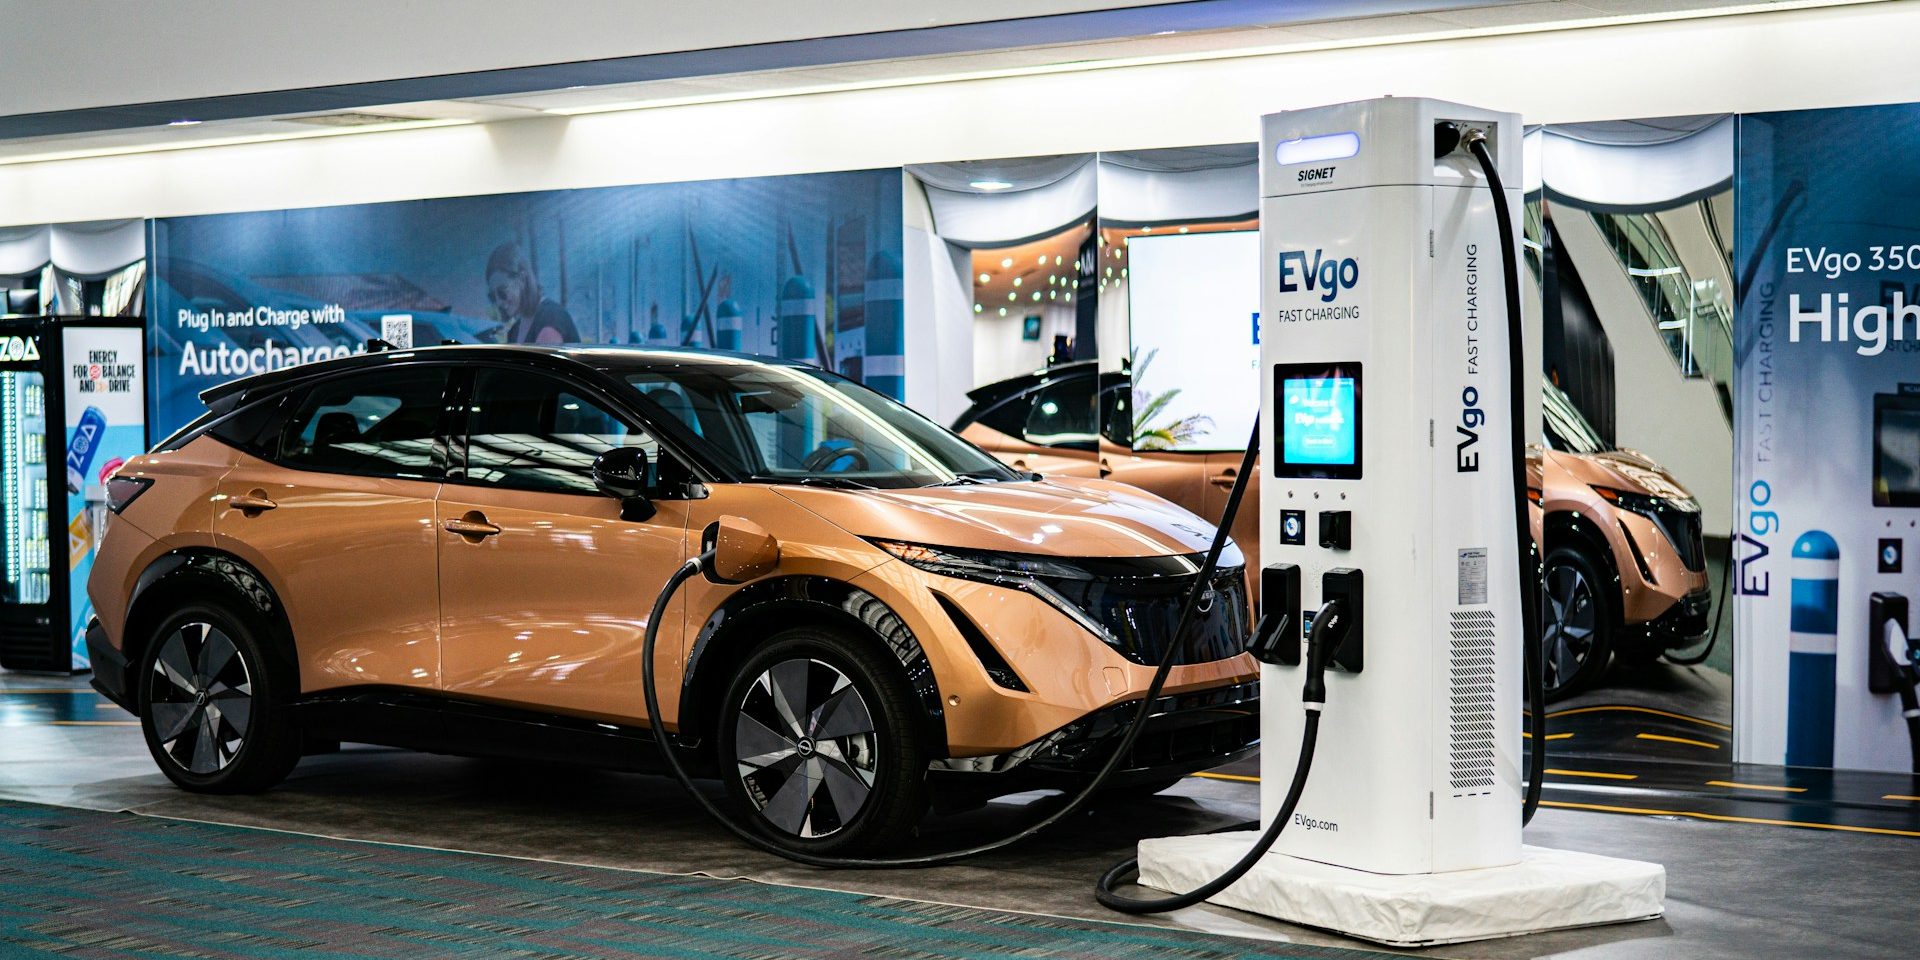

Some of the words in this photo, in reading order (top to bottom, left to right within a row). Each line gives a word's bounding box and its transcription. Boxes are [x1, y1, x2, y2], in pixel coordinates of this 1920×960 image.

[1298, 167, 1336, 181] SIGNET
[1279, 249, 1359, 302] EVgo
[1787, 247, 1861, 279] EVgo
[1466, 243, 1478, 331] CHARGING
[178, 309, 209, 332] Plug
[212, 308, 225, 326] In
[227, 307, 253, 326] and
[256, 304, 309, 330] Charge
[311, 303, 345, 324] with
[1279, 309, 1303, 322] FAST
[1305, 305, 1359, 321] CHARGING
[1789, 291, 1920, 356] High
[89, 350, 118, 363] ENERGY
[1467, 335, 1478, 375] FAST
[1758, 281, 1775, 403] CHARGING
[73, 364, 89, 378] FOR
[102, 364, 136, 378] BALANCE
[79, 379, 95, 393] AND
[109, 379, 131, 393] DRIVE
[1457, 386, 1485, 472] EVgo
[1757, 411, 1773, 462] FAST
[1741, 480, 1779, 596] EVgo
[1295, 813, 1339, 832] EVgo.com
